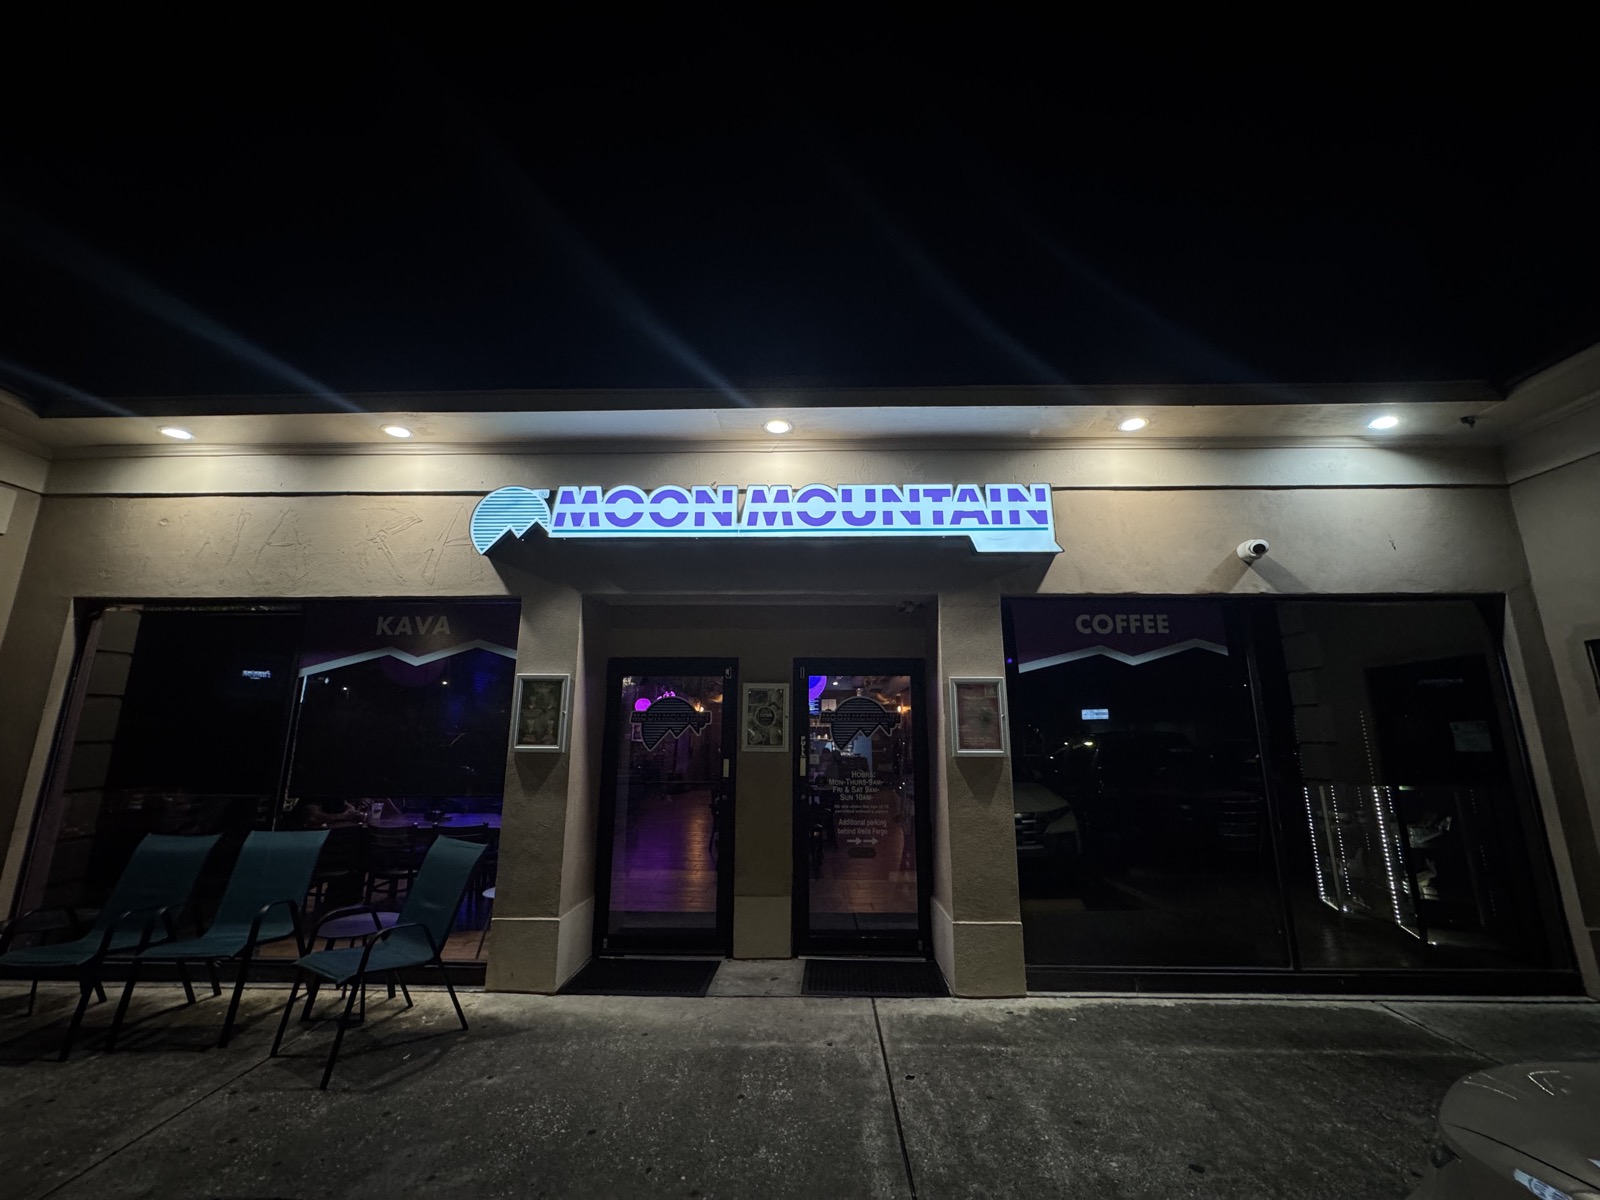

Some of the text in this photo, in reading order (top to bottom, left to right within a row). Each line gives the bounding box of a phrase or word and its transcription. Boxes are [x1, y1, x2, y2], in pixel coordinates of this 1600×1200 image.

[553, 488, 1049, 528] MOON MOUNTAIN
[375, 615, 451, 636] KAVA
[1075, 613, 1170, 635] COFFEE
